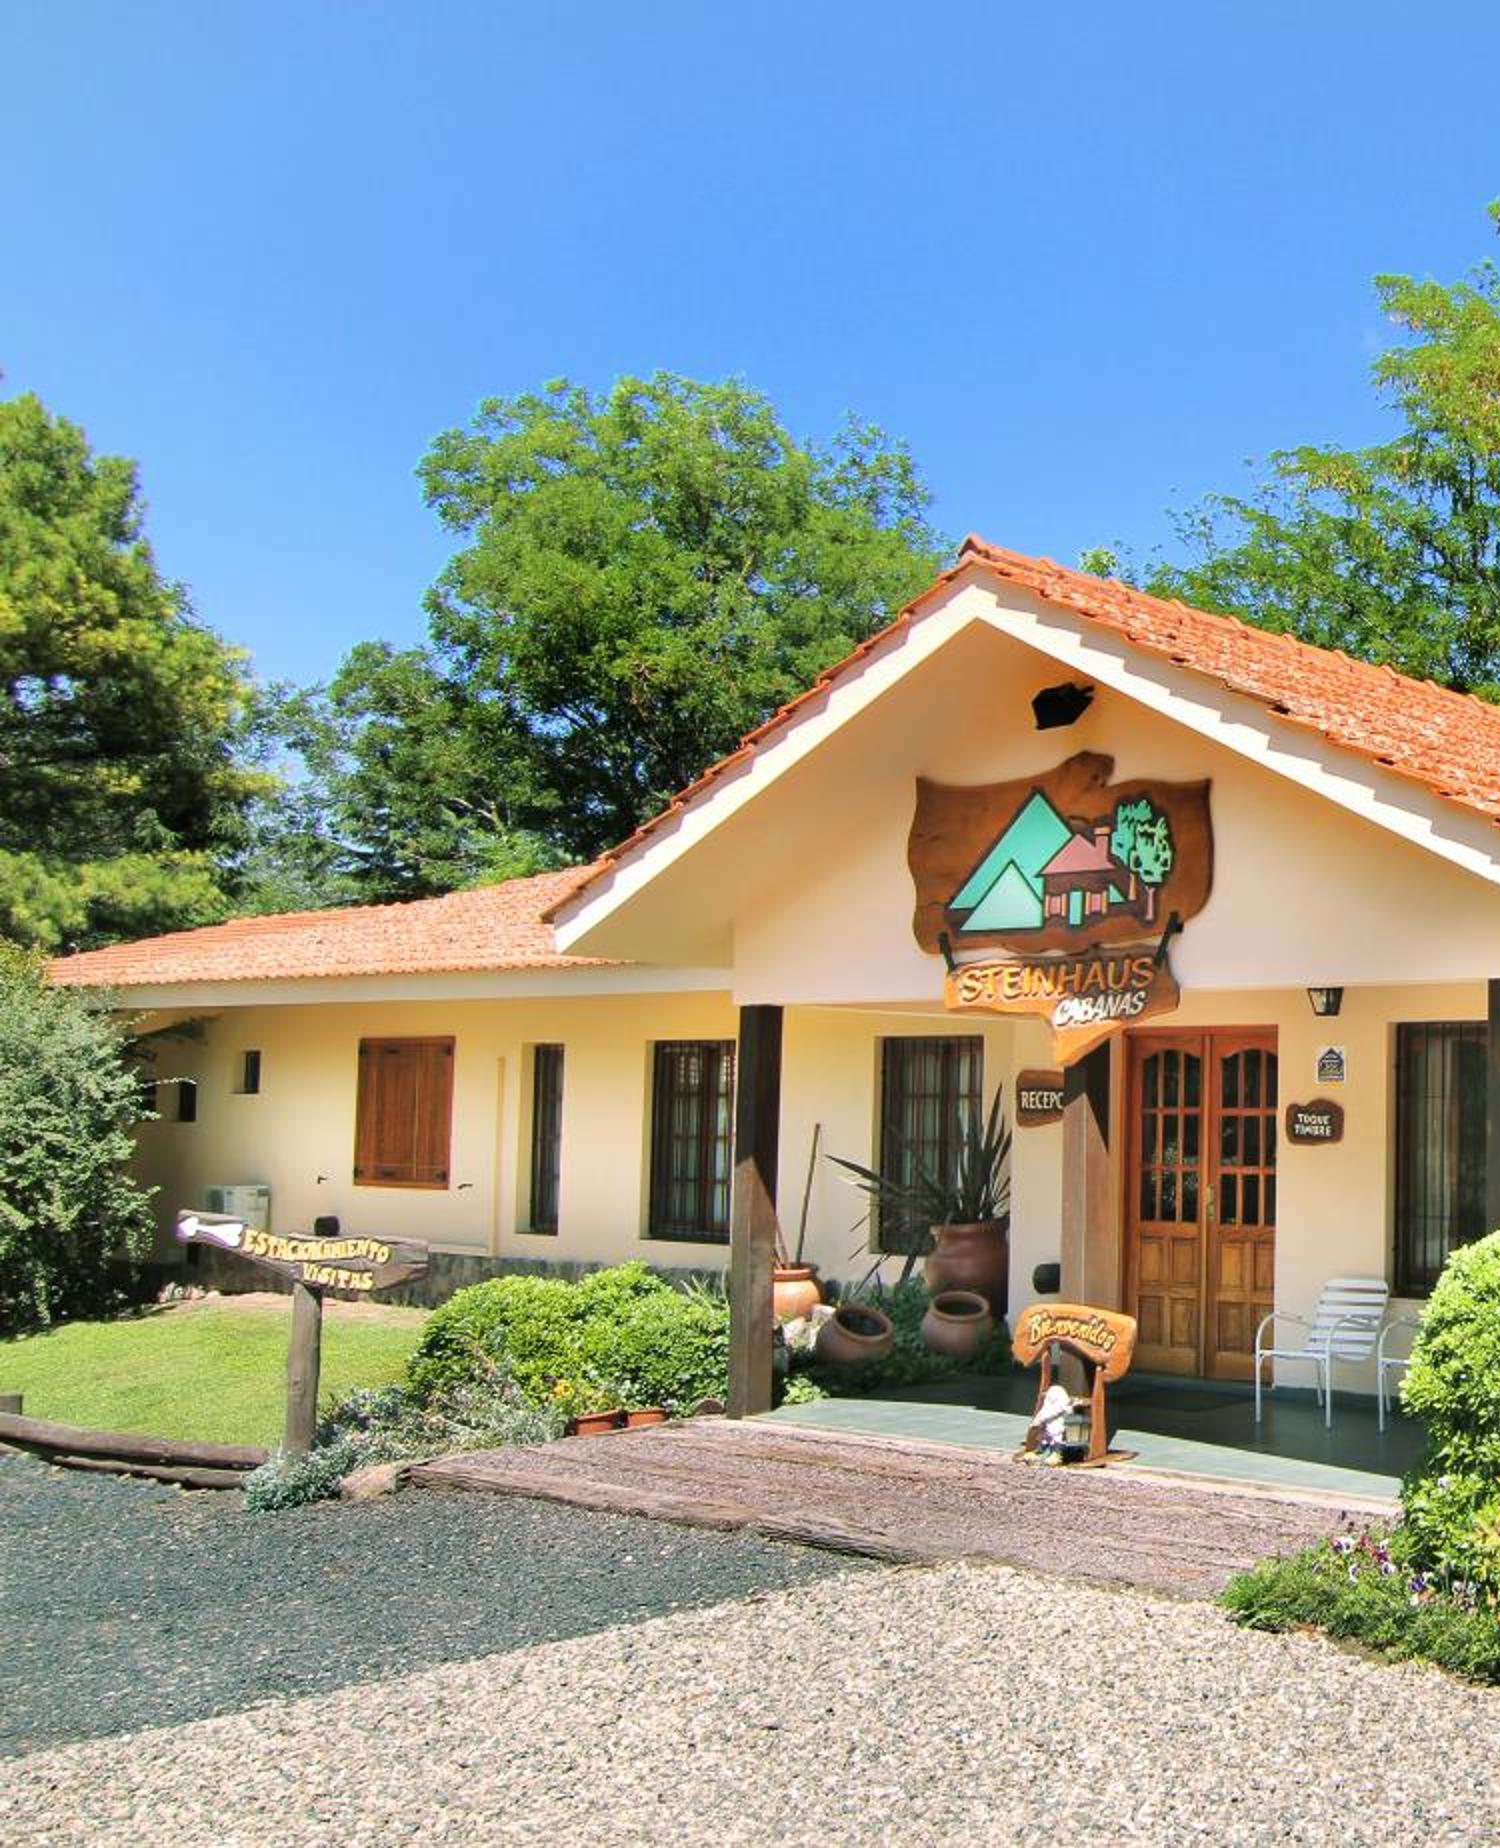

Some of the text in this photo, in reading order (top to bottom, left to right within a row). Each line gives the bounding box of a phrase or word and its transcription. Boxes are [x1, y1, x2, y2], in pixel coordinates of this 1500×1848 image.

[960, 957, 1153, 1002] STEINHAUS
[1294, 1123, 1331, 1137] TIMBRE
[1297, 1113, 1330, 1125] TOQUE
[243, 1230, 390, 1263] ESTACIONAMIENTO
[303, 1262, 374, 1290] VISITAS
[1030, 1312, 1115, 1350] Bienvenidos
